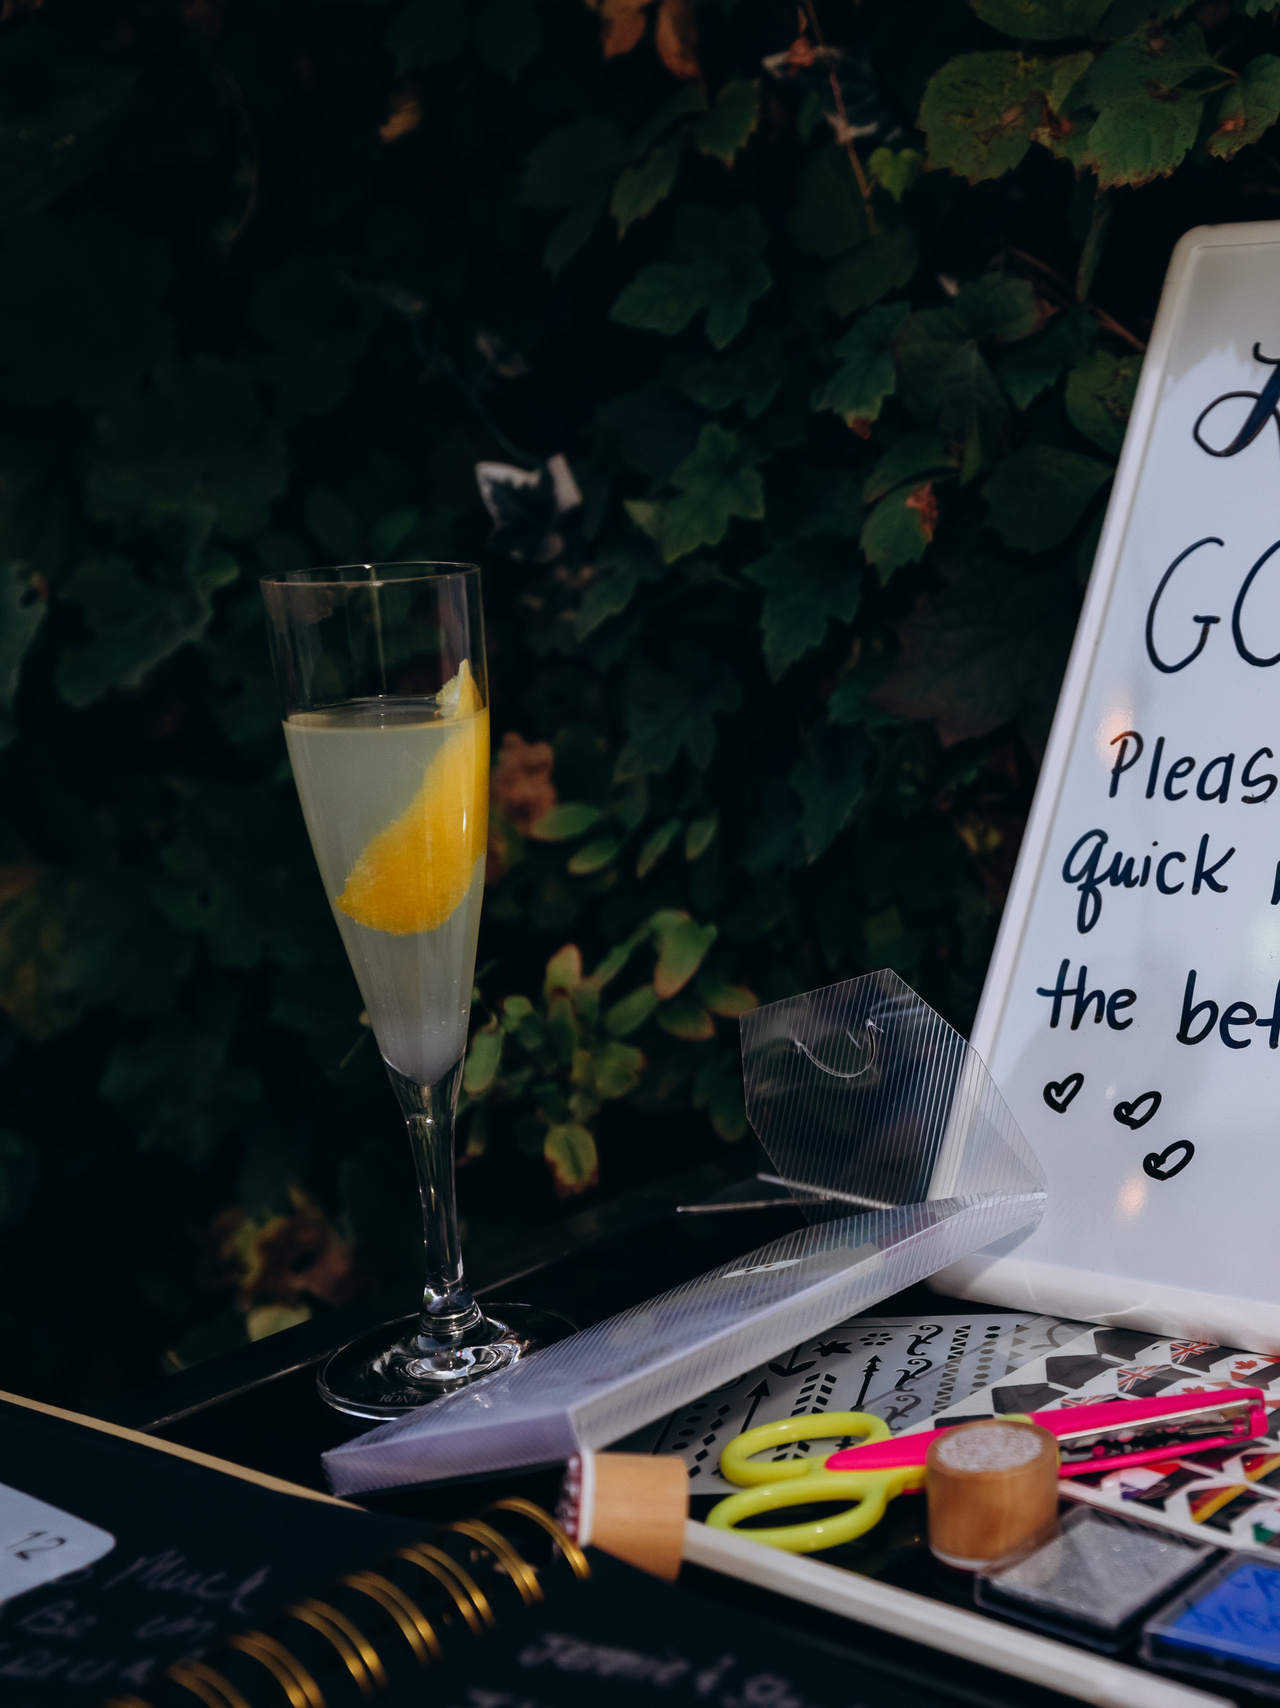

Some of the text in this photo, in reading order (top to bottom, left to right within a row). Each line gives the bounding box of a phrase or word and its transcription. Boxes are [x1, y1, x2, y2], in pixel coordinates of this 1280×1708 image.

[1062, 828, 1236, 935] quick
[1036, 958, 1138, 1031] the
[5, 1531, 66, 1560] 12
